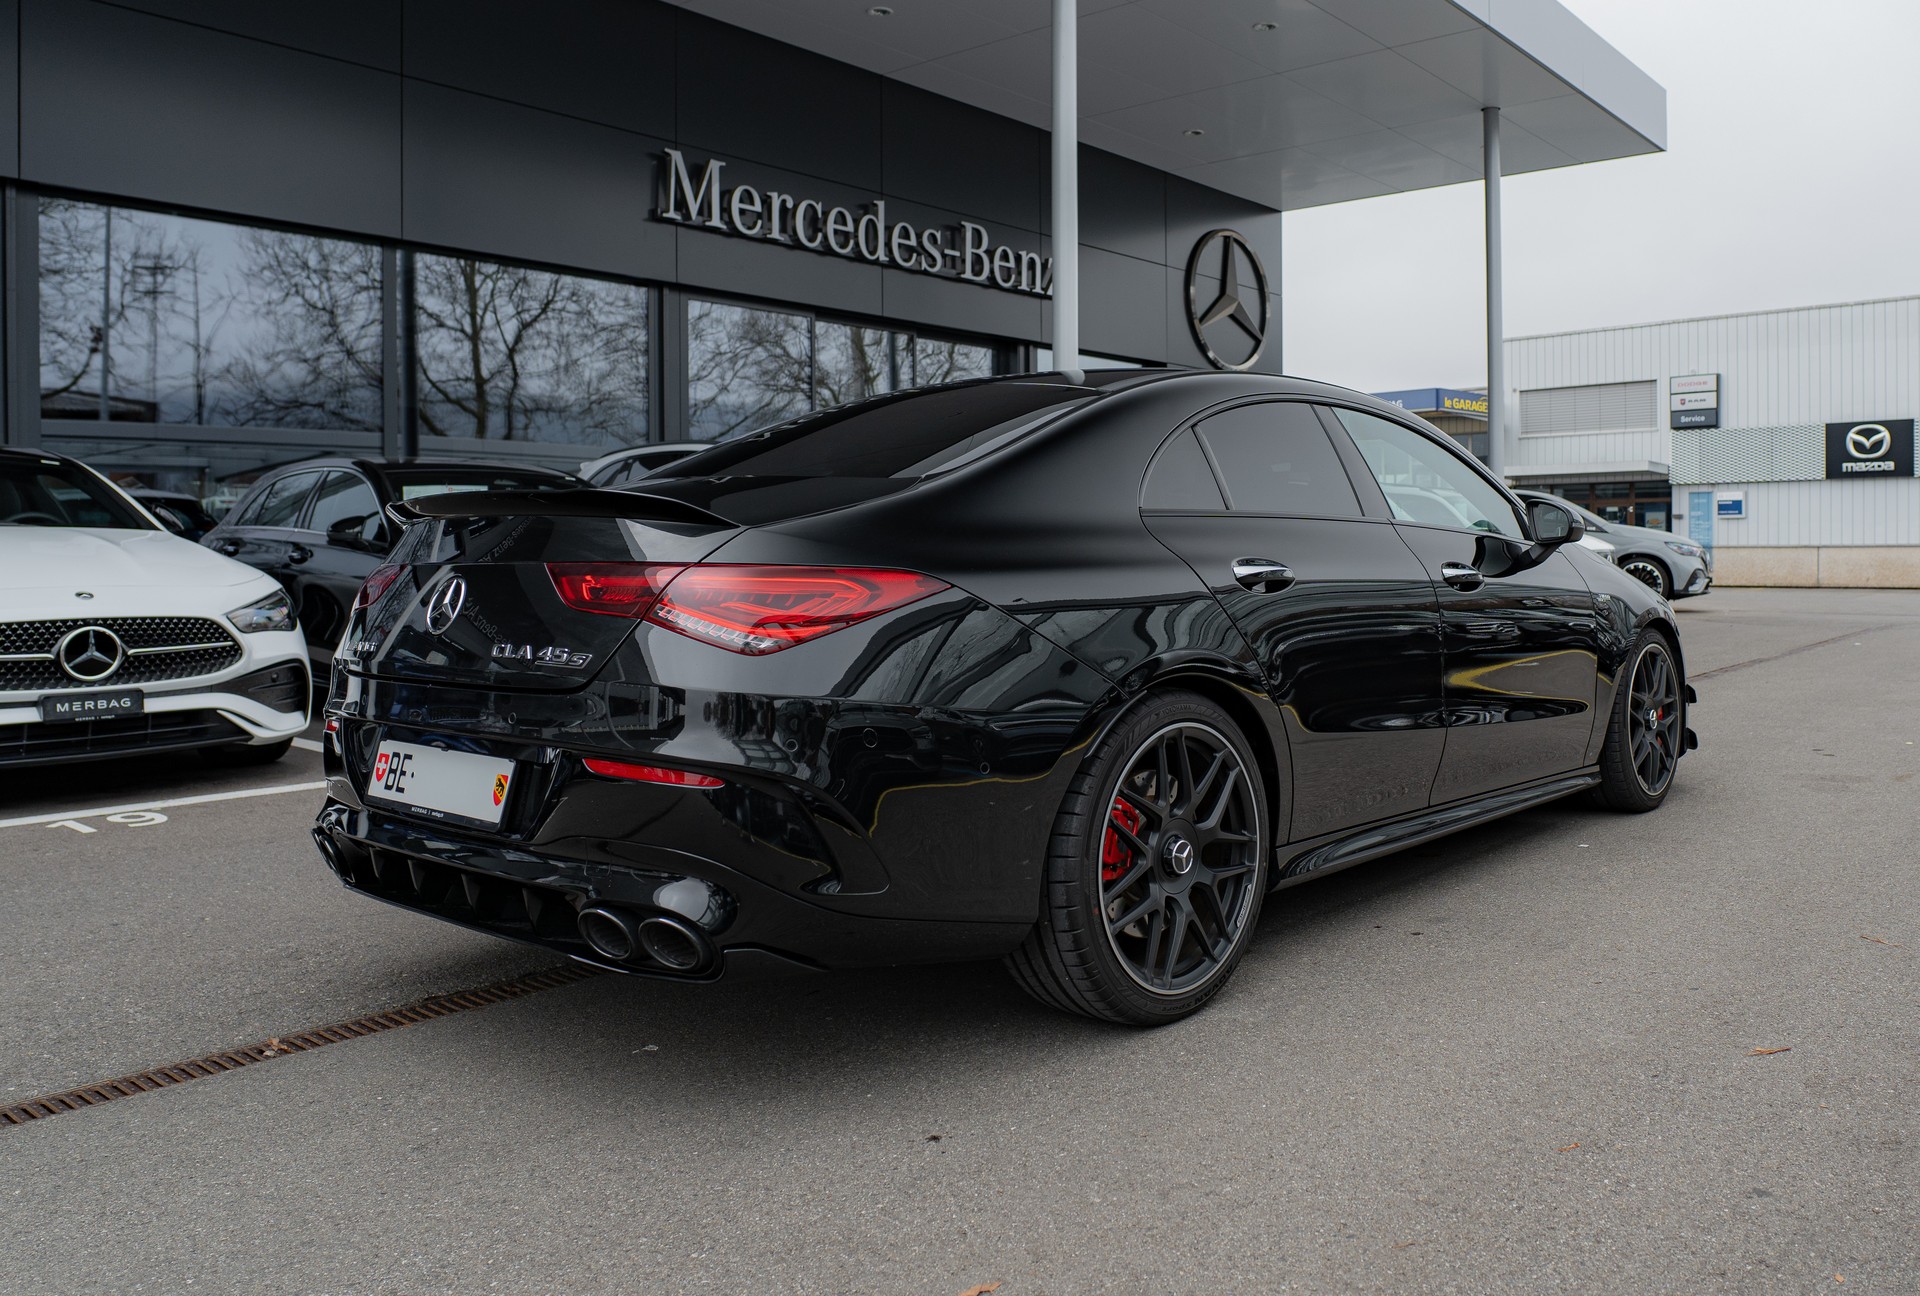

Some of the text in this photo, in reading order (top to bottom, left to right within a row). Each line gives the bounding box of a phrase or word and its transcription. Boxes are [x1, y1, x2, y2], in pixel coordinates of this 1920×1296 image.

[1453, 398, 1488, 412] GARAGE
[1680, 415, 1706, 423] Service
[491, 643, 533, 660] CLA
[56, 697, 131, 713] MERBAG
